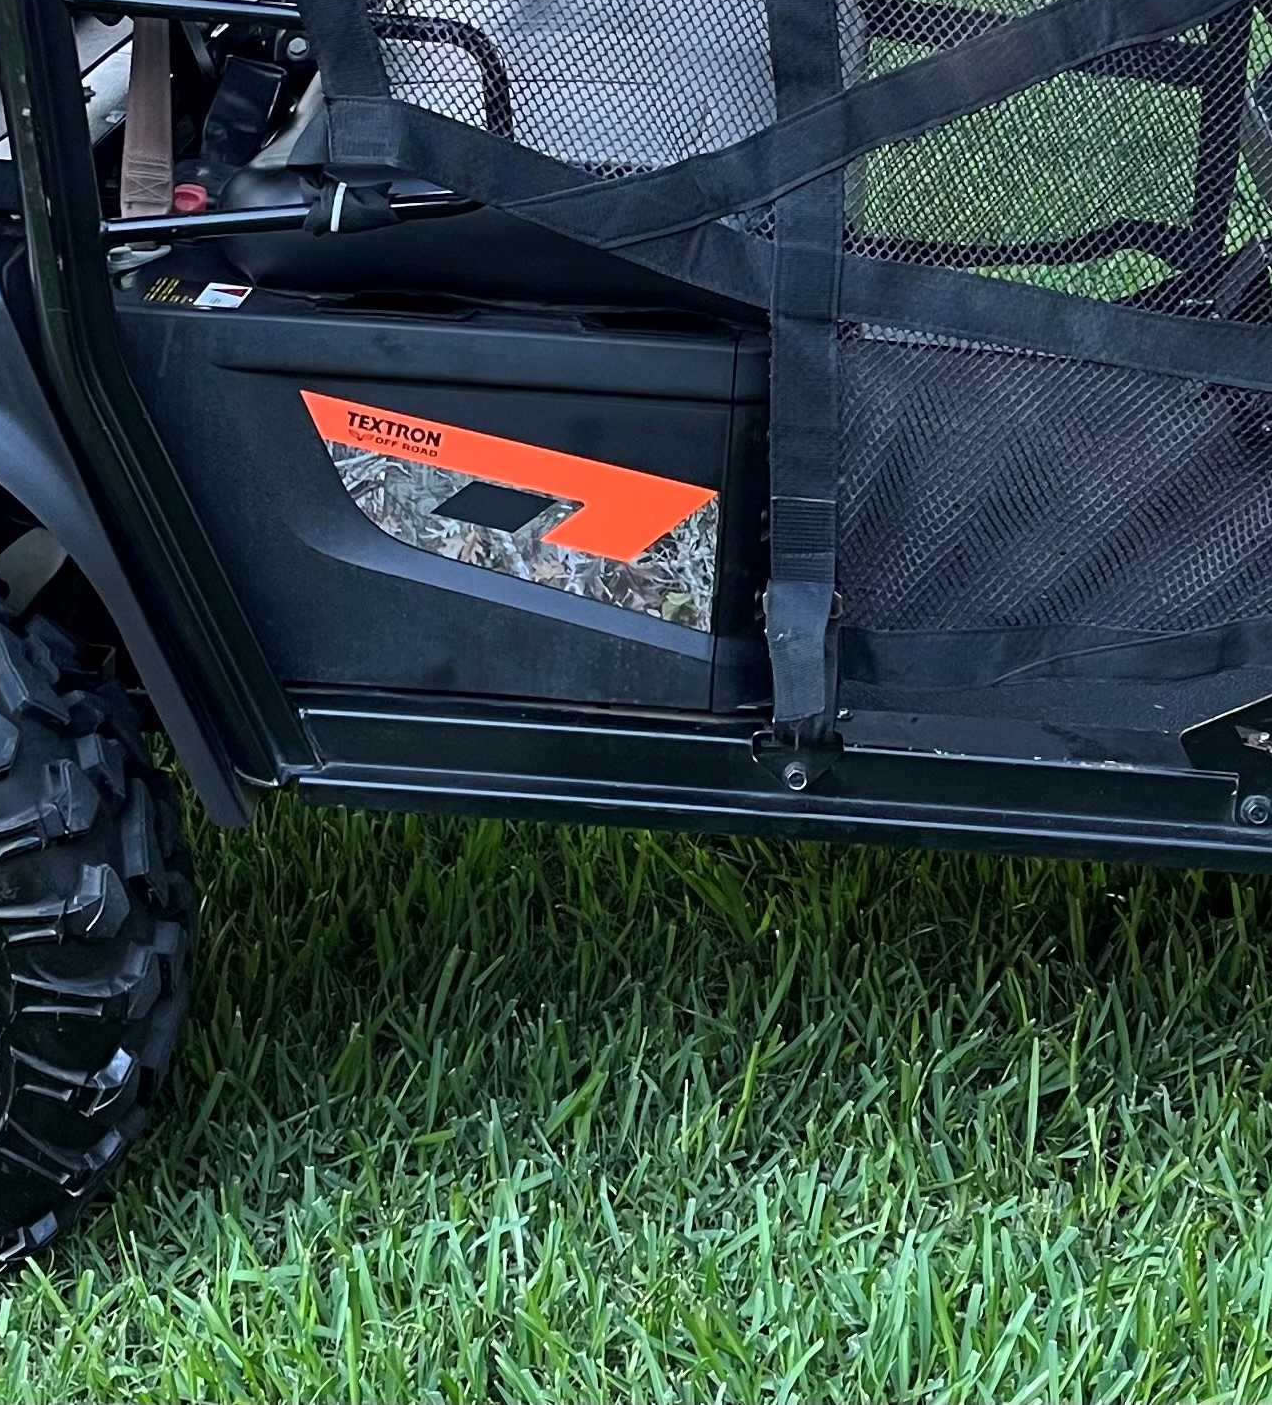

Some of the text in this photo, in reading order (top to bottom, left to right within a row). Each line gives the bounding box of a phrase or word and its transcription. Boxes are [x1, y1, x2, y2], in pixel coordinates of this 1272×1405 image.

[347, 410, 442, 448] TEXTRON
[375, 436, 438, 458] OFF ROAD
